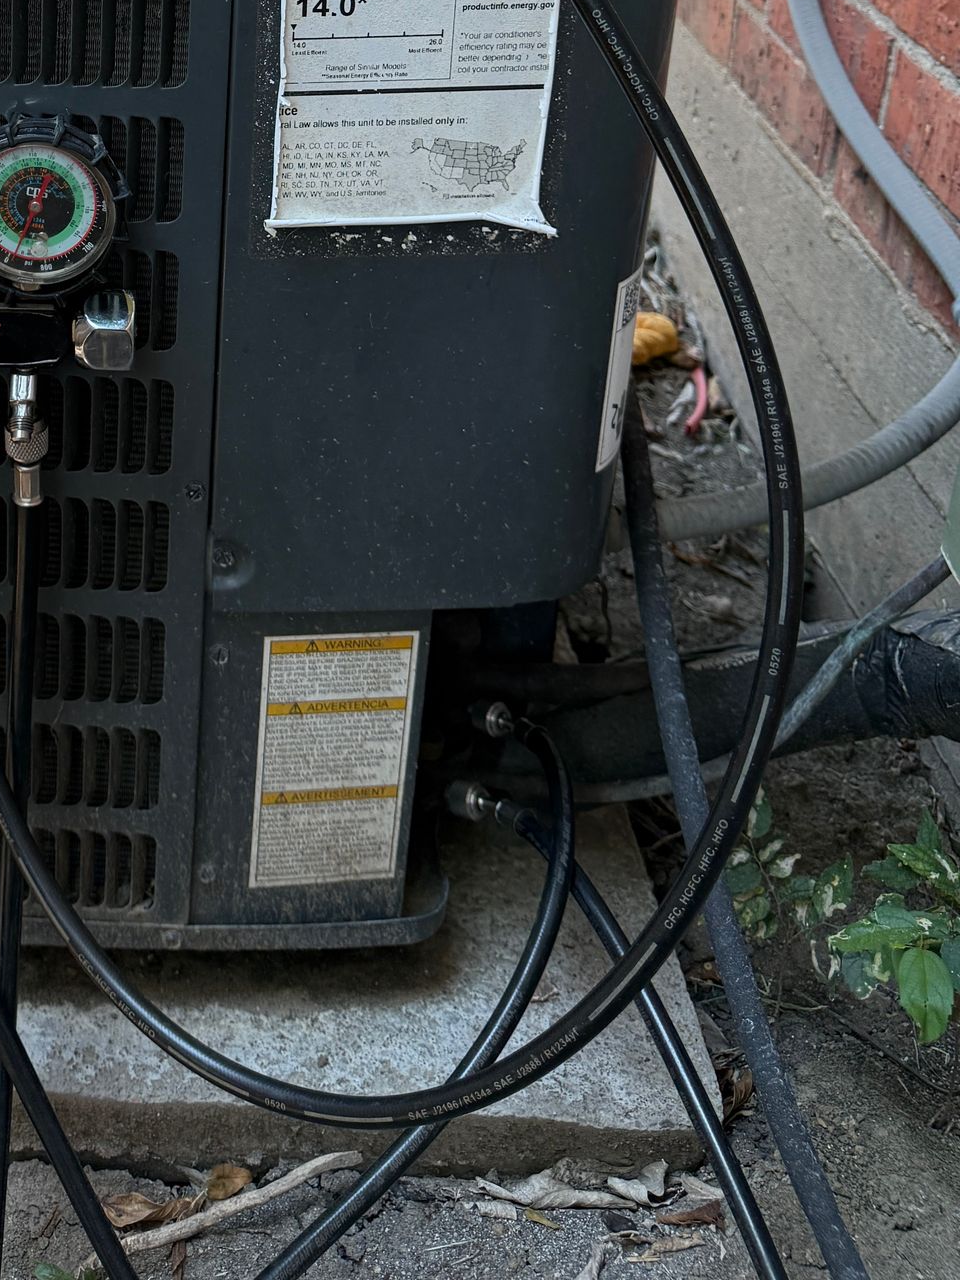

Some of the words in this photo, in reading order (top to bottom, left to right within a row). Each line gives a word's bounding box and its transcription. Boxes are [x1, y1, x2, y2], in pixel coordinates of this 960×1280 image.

[462, 2, 554, 12] productinfo.energy.gov
[592, 10, 610, 32] HFO
[495, 30, 542, 38] conditioner's
[496, 43, 517, 51] rating
[608, 32, 625, 59] HFC,
[482, 54, 522, 62] depending
[623, 57, 645, 93] HCFC,
[642, 94, 659, 120] CFC,
[435, 118, 454, 127] only
[82, 241, 94, 253] 700
[750, 348, 767, 373] SAE
[777, 464, 788, 488] SAE
[325, 639, 382, 649] WARNING
[768, 647, 782, 676] 0520
[307, 700, 389, 712] ADVERTENCIA
[664, 907, 685, 930] CFC,
[680, 874, 704, 905] HCFC,
[698, 847, 718, 872] HFC,
[712, 819, 729, 844] HFO
[264, 1097, 286, 1112] 0520
[408, 1109, 429, 1121] SAE
[493, 1074, 515, 1091] SAE
